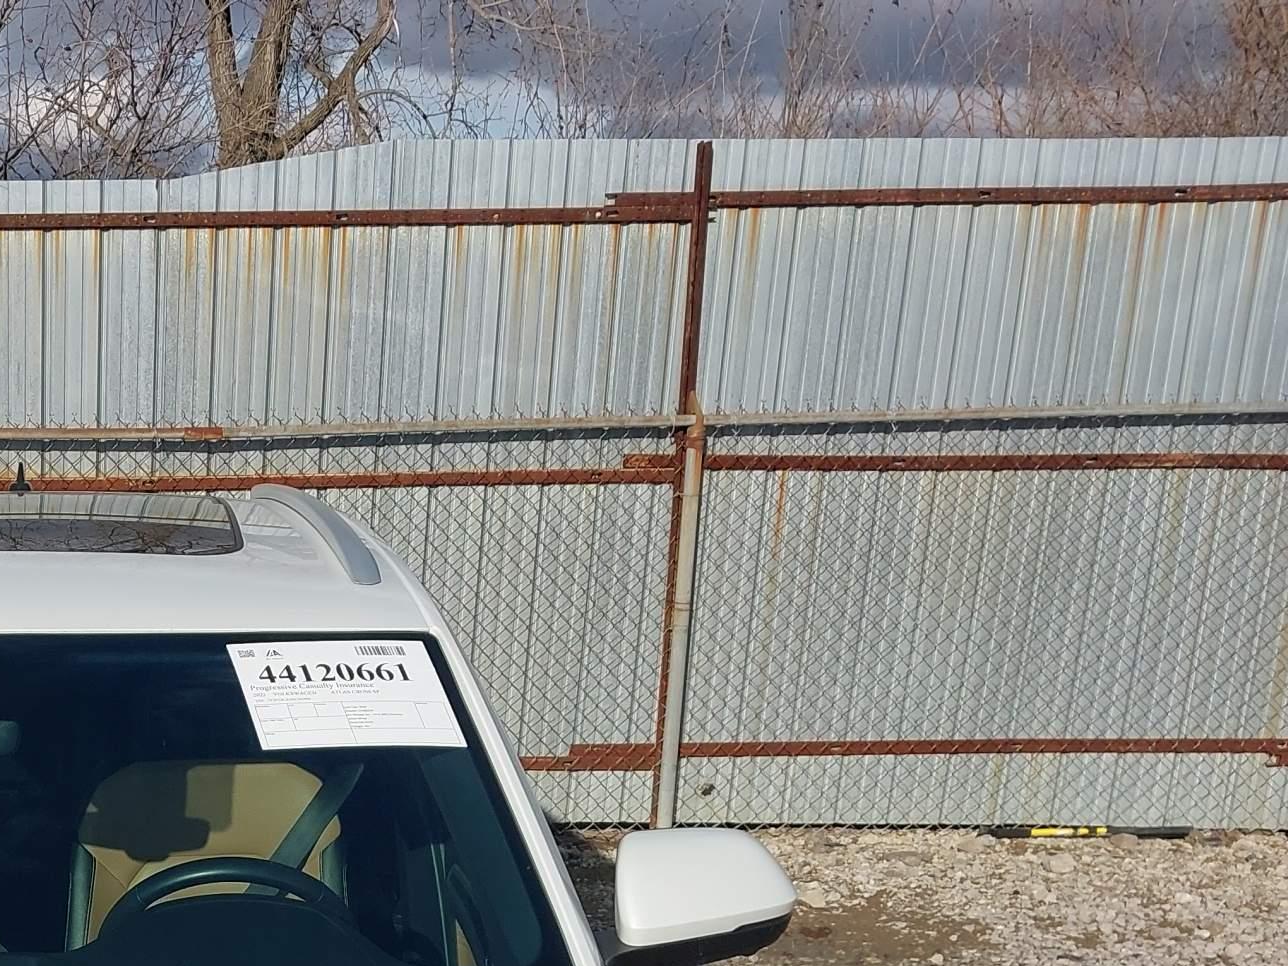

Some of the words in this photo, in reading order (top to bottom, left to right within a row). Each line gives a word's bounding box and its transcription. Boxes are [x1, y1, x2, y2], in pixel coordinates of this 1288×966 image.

[258, 662, 414, 684] 44120661
[250, 684, 297, 692] Progressive
[299, 682, 334, 690] Casualty
